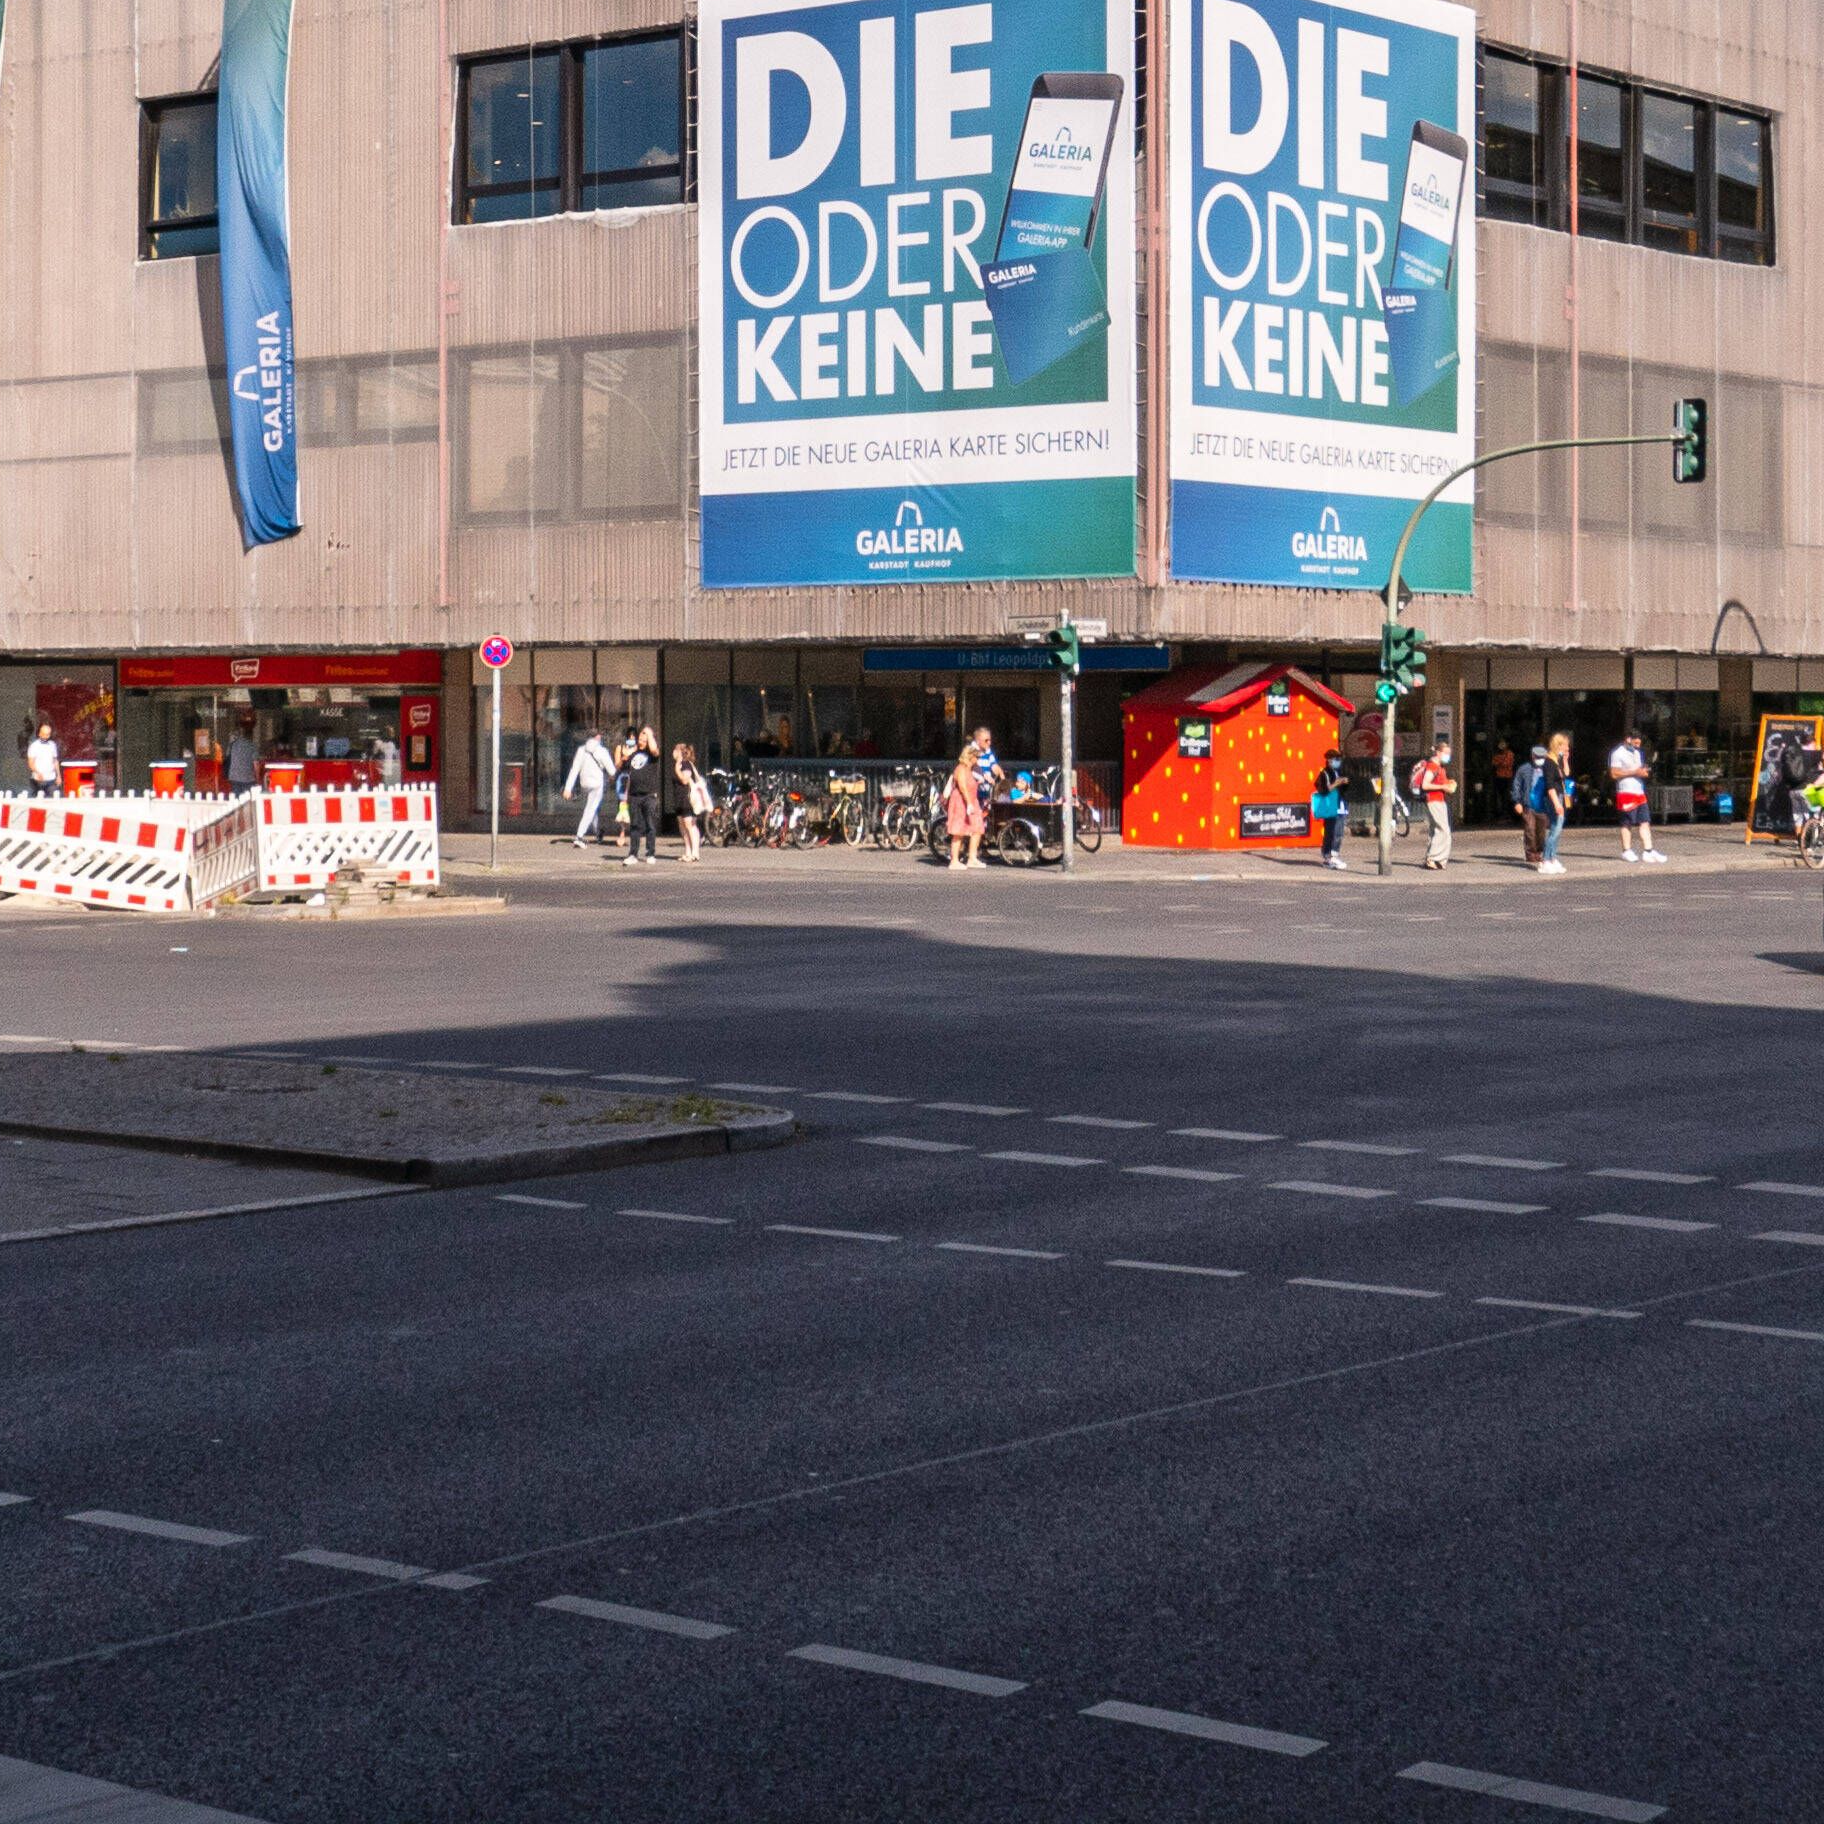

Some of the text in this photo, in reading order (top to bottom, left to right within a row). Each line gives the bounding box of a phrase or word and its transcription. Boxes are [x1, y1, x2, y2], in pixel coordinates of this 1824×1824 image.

[735, 2, 994, 200] DIE
[1029, 142, 1093, 162] GALERIA
[1410, 182, 1451, 211] GALERIA
[730, 186, 987, 310] ODER
[1196, 179, 1386, 311] ODER
[988, 263, 1037, 285] GALERIA
[735, 296, 995, 405] KEINE
[1203, 296, 1391, 407] KEINE
[255, 310, 283, 452] GALERIA
[722, 429, 1110, 472] JETZT DIE NEUE GALERIA KARTE SICHERN!
[1190, 432, 1459, 476] JETZT DIE NEUE GALERIA KARTE SICHERN!
[856, 527, 964, 556] GALERIA
[1292, 532, 1368, 561] GALERIA
[868, 558, 952, 570] KARSTADT KAUFHOF
